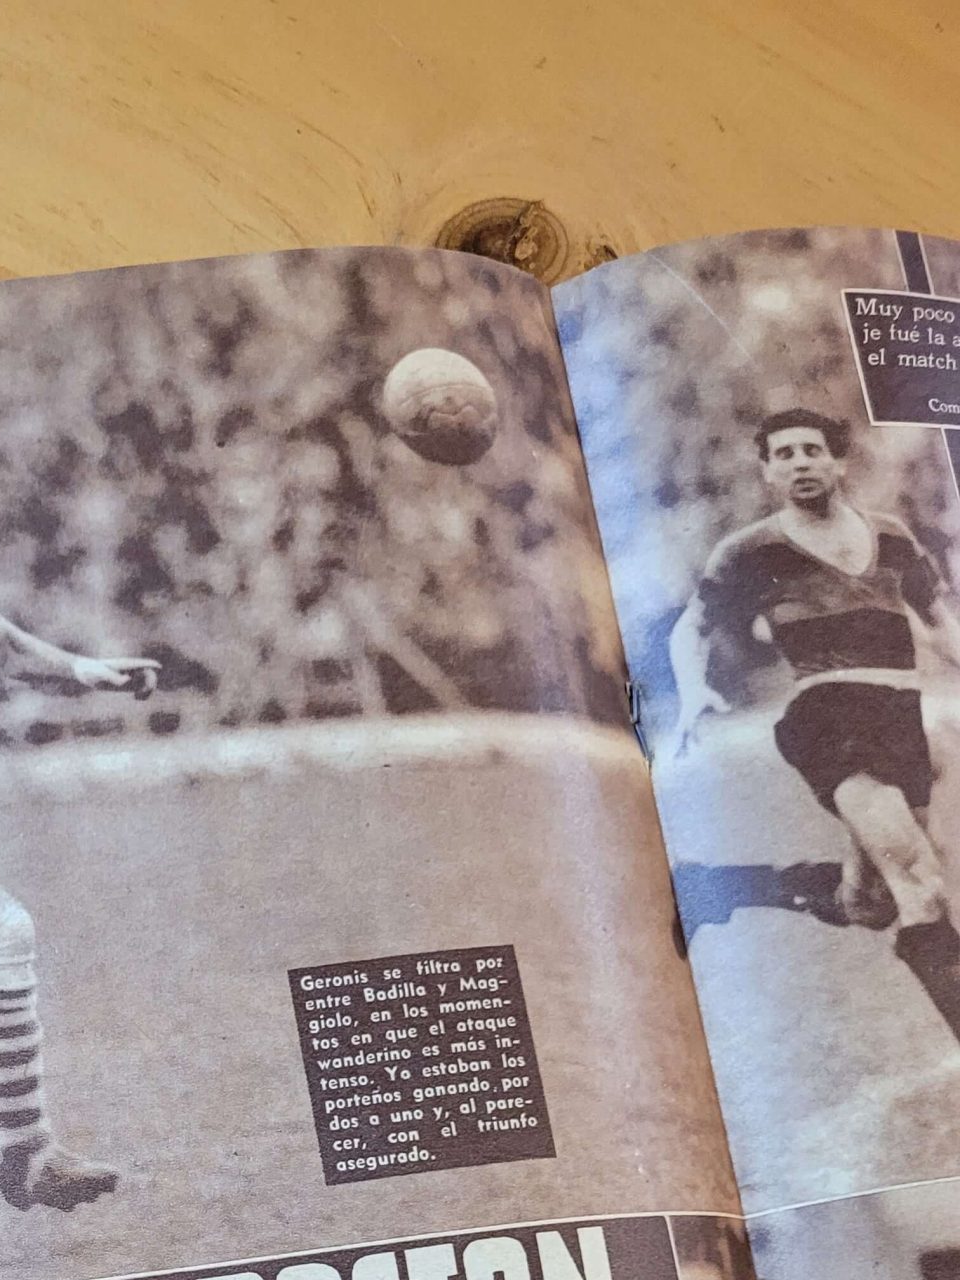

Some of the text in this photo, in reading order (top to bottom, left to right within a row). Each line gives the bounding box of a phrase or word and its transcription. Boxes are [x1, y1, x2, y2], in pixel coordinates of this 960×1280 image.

[855, 298, 955, 323] Muy poco
[863, 323, 881, 344] je
[890, 324, 920, 342] fué
[928, 328, 946, 346] la
[868, 348, 957, 370] el match
[300, 970, 368, 991] Geronis
[383, 968, 401, 980] se
[416, 960, 460, 975] filtra
[305, 976, 508, 1011] entre Badilla y Mag-
[309, 997, 511, 1034] giolo, en los momen-
[313, 1015, 517, 1050] tos en que el ataque
[317, 1034, 521, 1070] wanderino es más in-
[320, 1053, 526, 1090] tenso. Ya estaban los
[325, 1087, 402, 1114] porteños
[502, 1075, 530, 1092] por
[329, 1096, 533, 1131] dos a uno y, al pare-
[333, 1113, 538, 1150] cer, con el triunfo
[337, 1146, 436, 1171] asegurado.
